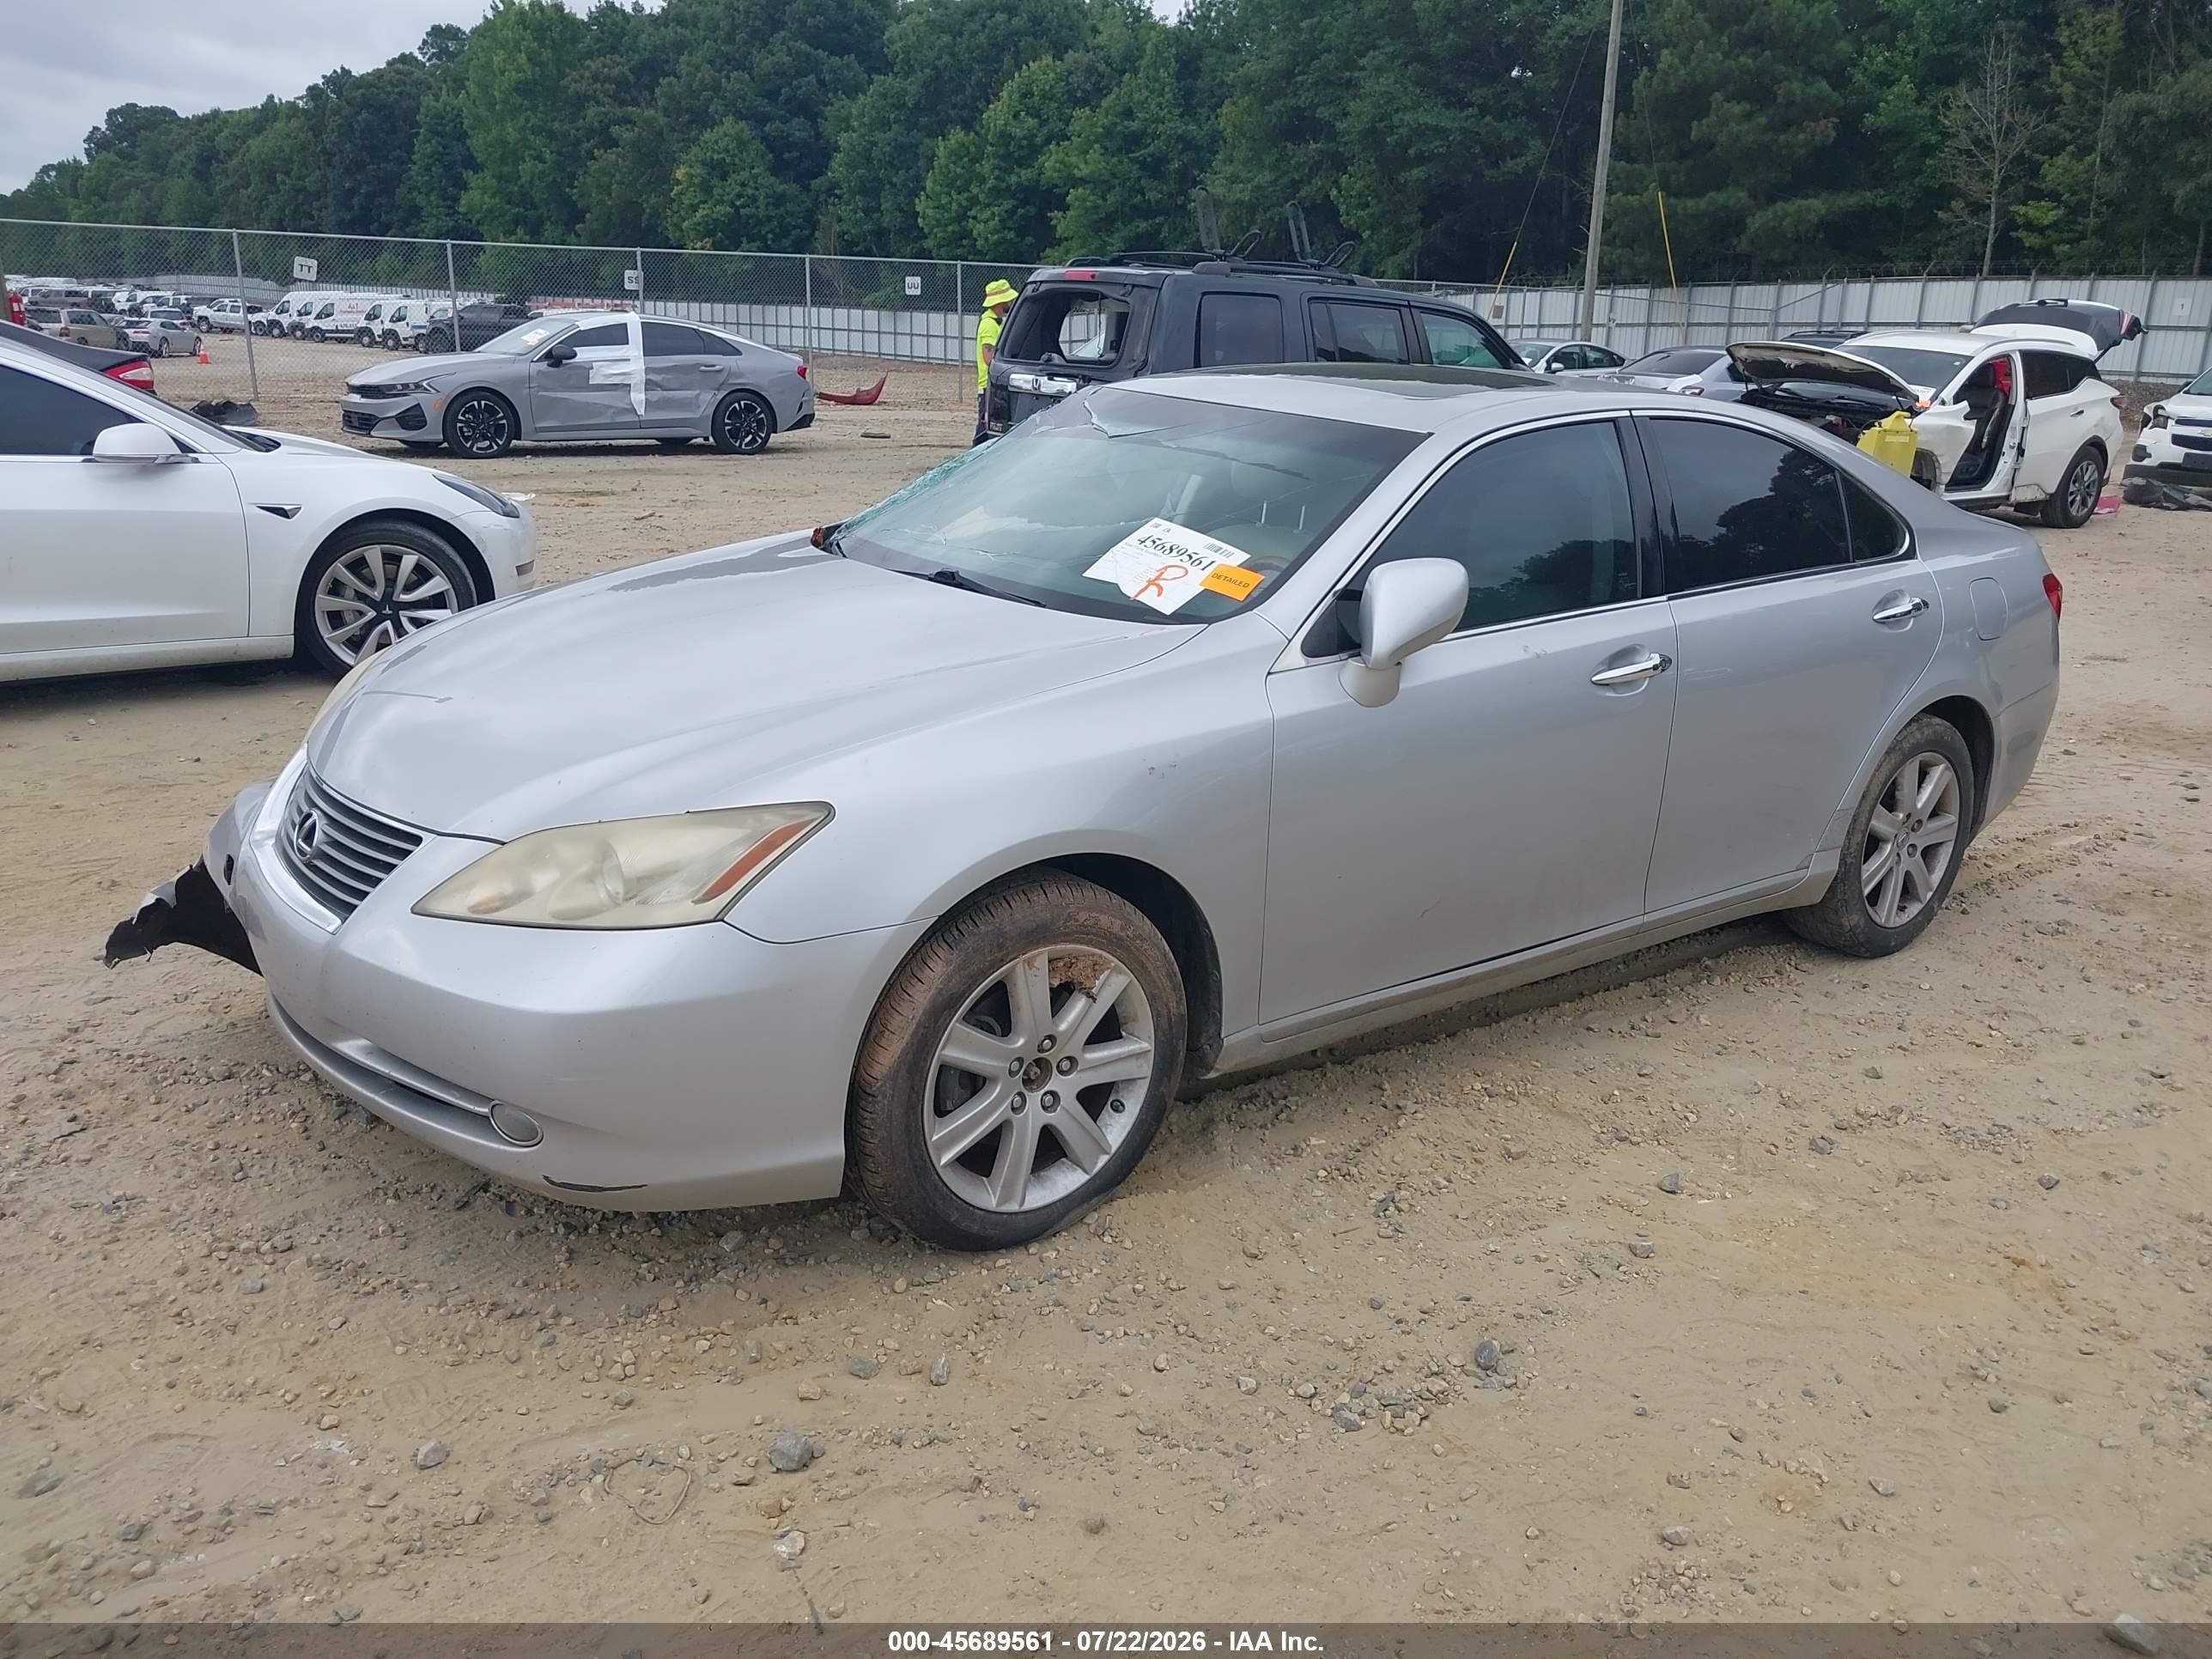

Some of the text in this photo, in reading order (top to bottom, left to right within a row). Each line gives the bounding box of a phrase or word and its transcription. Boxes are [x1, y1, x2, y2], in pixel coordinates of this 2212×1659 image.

[298, 264, 313, 274] TT
[1137, 534, 1216, 572] 45689561
[1130, 564, 1189, 600] R
[1211, 572, 1250, 588] DETAILED
